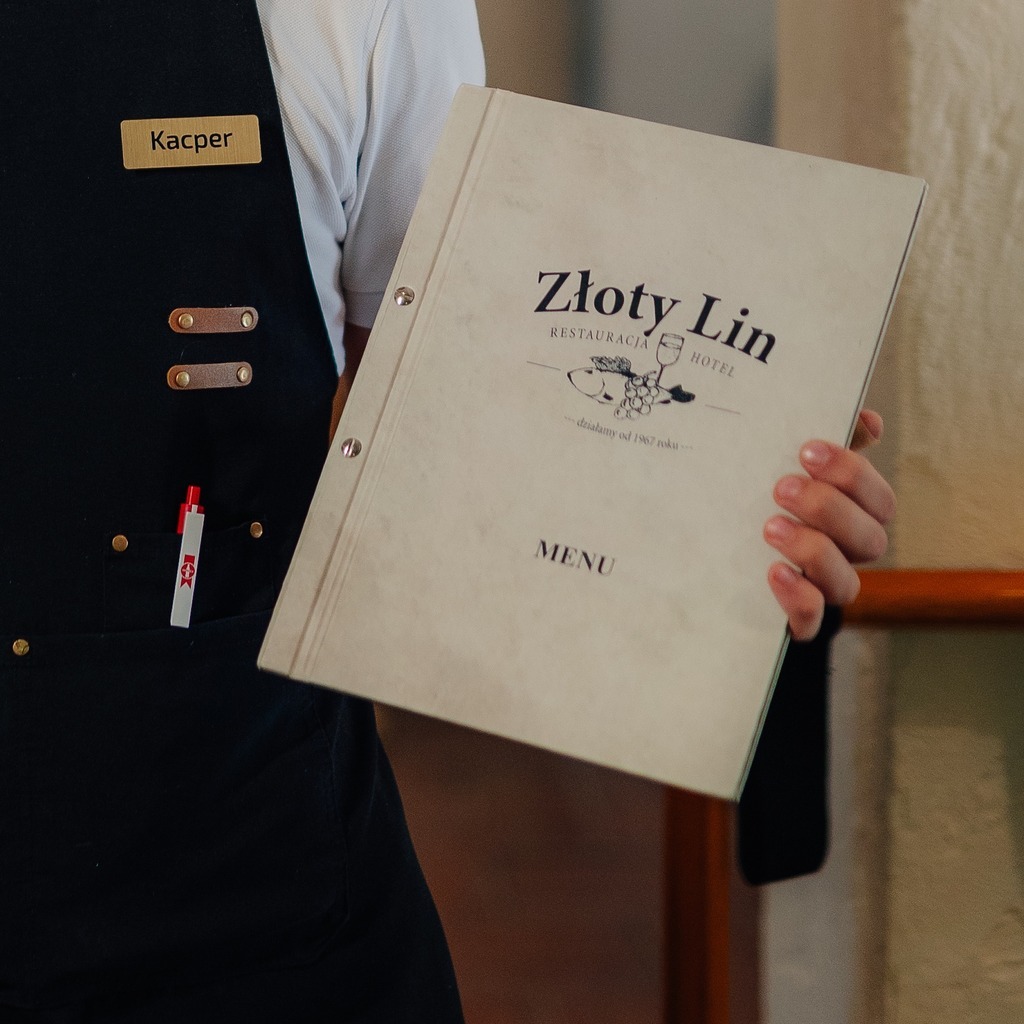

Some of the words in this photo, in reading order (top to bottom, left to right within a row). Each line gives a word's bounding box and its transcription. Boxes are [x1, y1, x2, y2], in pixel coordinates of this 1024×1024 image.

[150, 130, 233, 154] Kacper
[533, 269, 682, 337] Złoty
[686, 292, 779, 364] Lin
[549, 326, 650, 350] RESTAURACJA
[690, 351, 736, 378] HOTEL
[576, 417, 618, 440] działamy
[619, 431, 632, 442] od
[657, 437, 679, 451] roku
[534, 538, 617, 577] MENU
